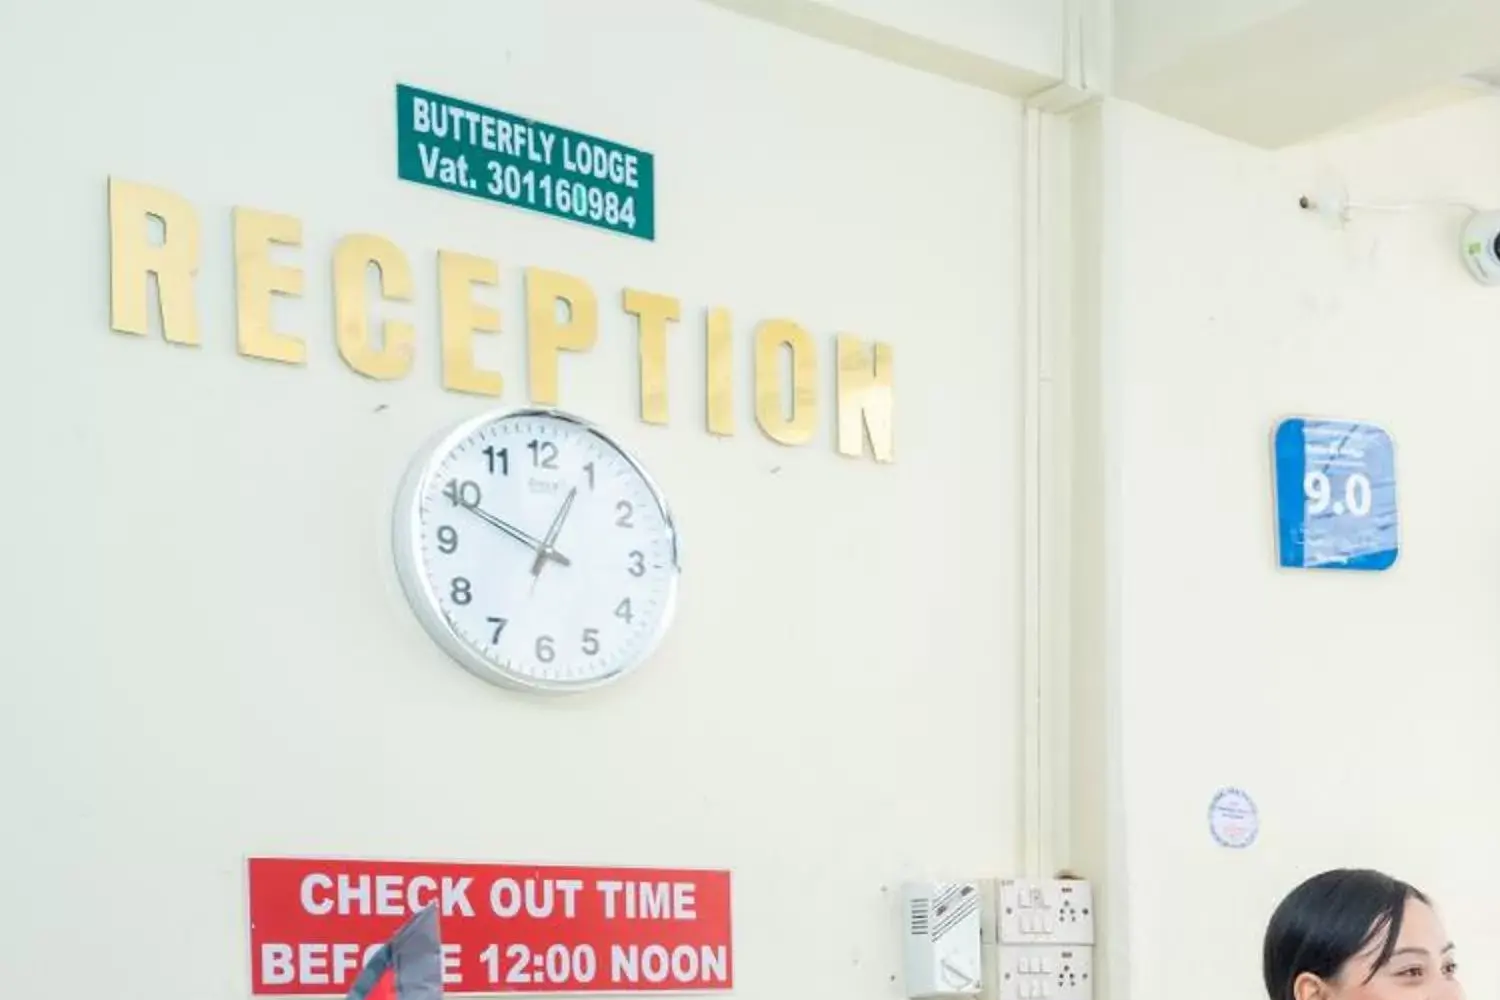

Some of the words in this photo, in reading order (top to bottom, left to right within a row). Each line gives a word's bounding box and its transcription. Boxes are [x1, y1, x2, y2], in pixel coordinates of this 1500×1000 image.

[413, 96, 555, 165] BUTTERFLY
[563, 137, 639, 188] LODGE
[418, 144, 477, 189] Vat.
[487, 160, 636, 229] 301160984
[107, 175, 894, 464] RECEPTION
[482, 445, 509, 476] 11
[527, 439, 558, 470] 12
[583, 462, 595, 491] 1
[443, 478, 481, 509] 10
[1303, 471, 1372, 517] 9.0
[615, 500, 634, 529] 2
[437, 525, 458, 554] 9
[627, 550, 646, 577] 3
[451, 576, 472, 606] 8
[614, 597, 633, 624] 4
[486, 616, 508, 645] 7
[581, 628, 599, 656] 5
[535, 635, 555, 663] 6
[300, 873, 476, 917] CHECK
[490, 877, 583, 919] OUT
[596, 880, 697, 920] TIME
[260, 943, 462, 985] BEFE
[479, 943, 596, 984] 12:00
[611, 944, 727, 983] NOON
